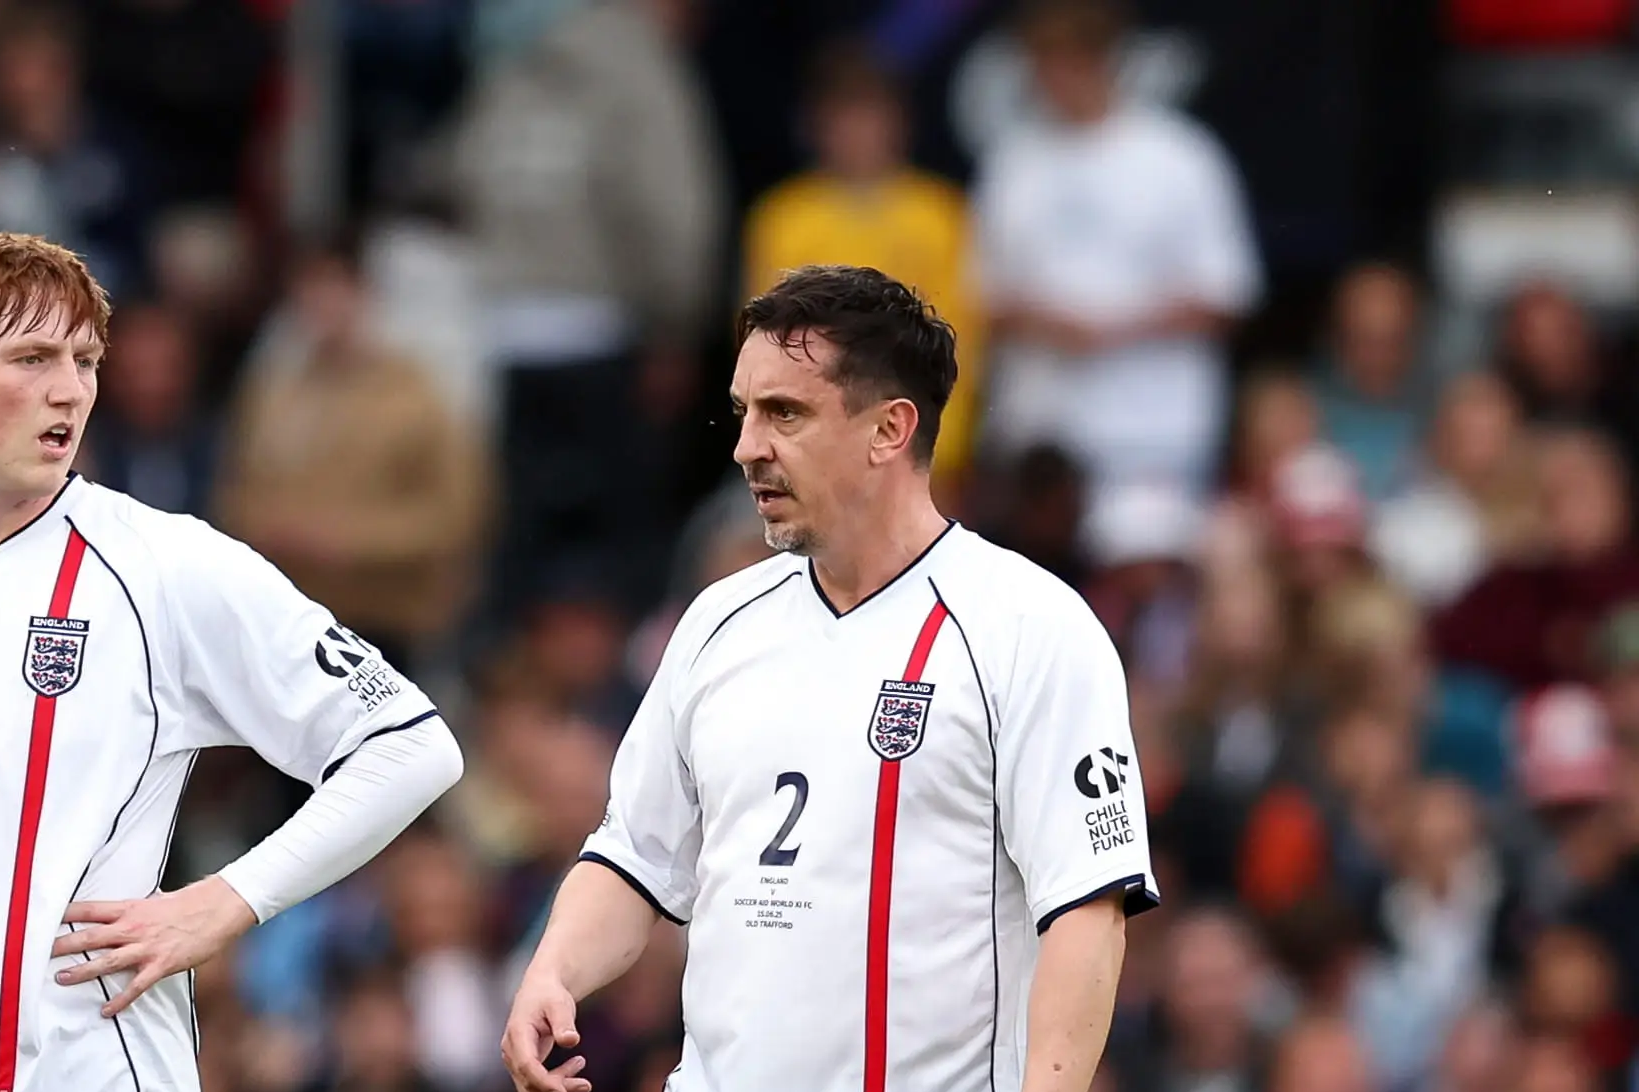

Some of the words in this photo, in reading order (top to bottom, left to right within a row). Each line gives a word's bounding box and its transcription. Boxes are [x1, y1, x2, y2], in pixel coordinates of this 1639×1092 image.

[32, 618, 85, 630] ENGLAND
[883, 681, 931, 693] ENGLAND
[759, 771, 809, 867] 2
[1092, 829, 1136, 856] FUND
